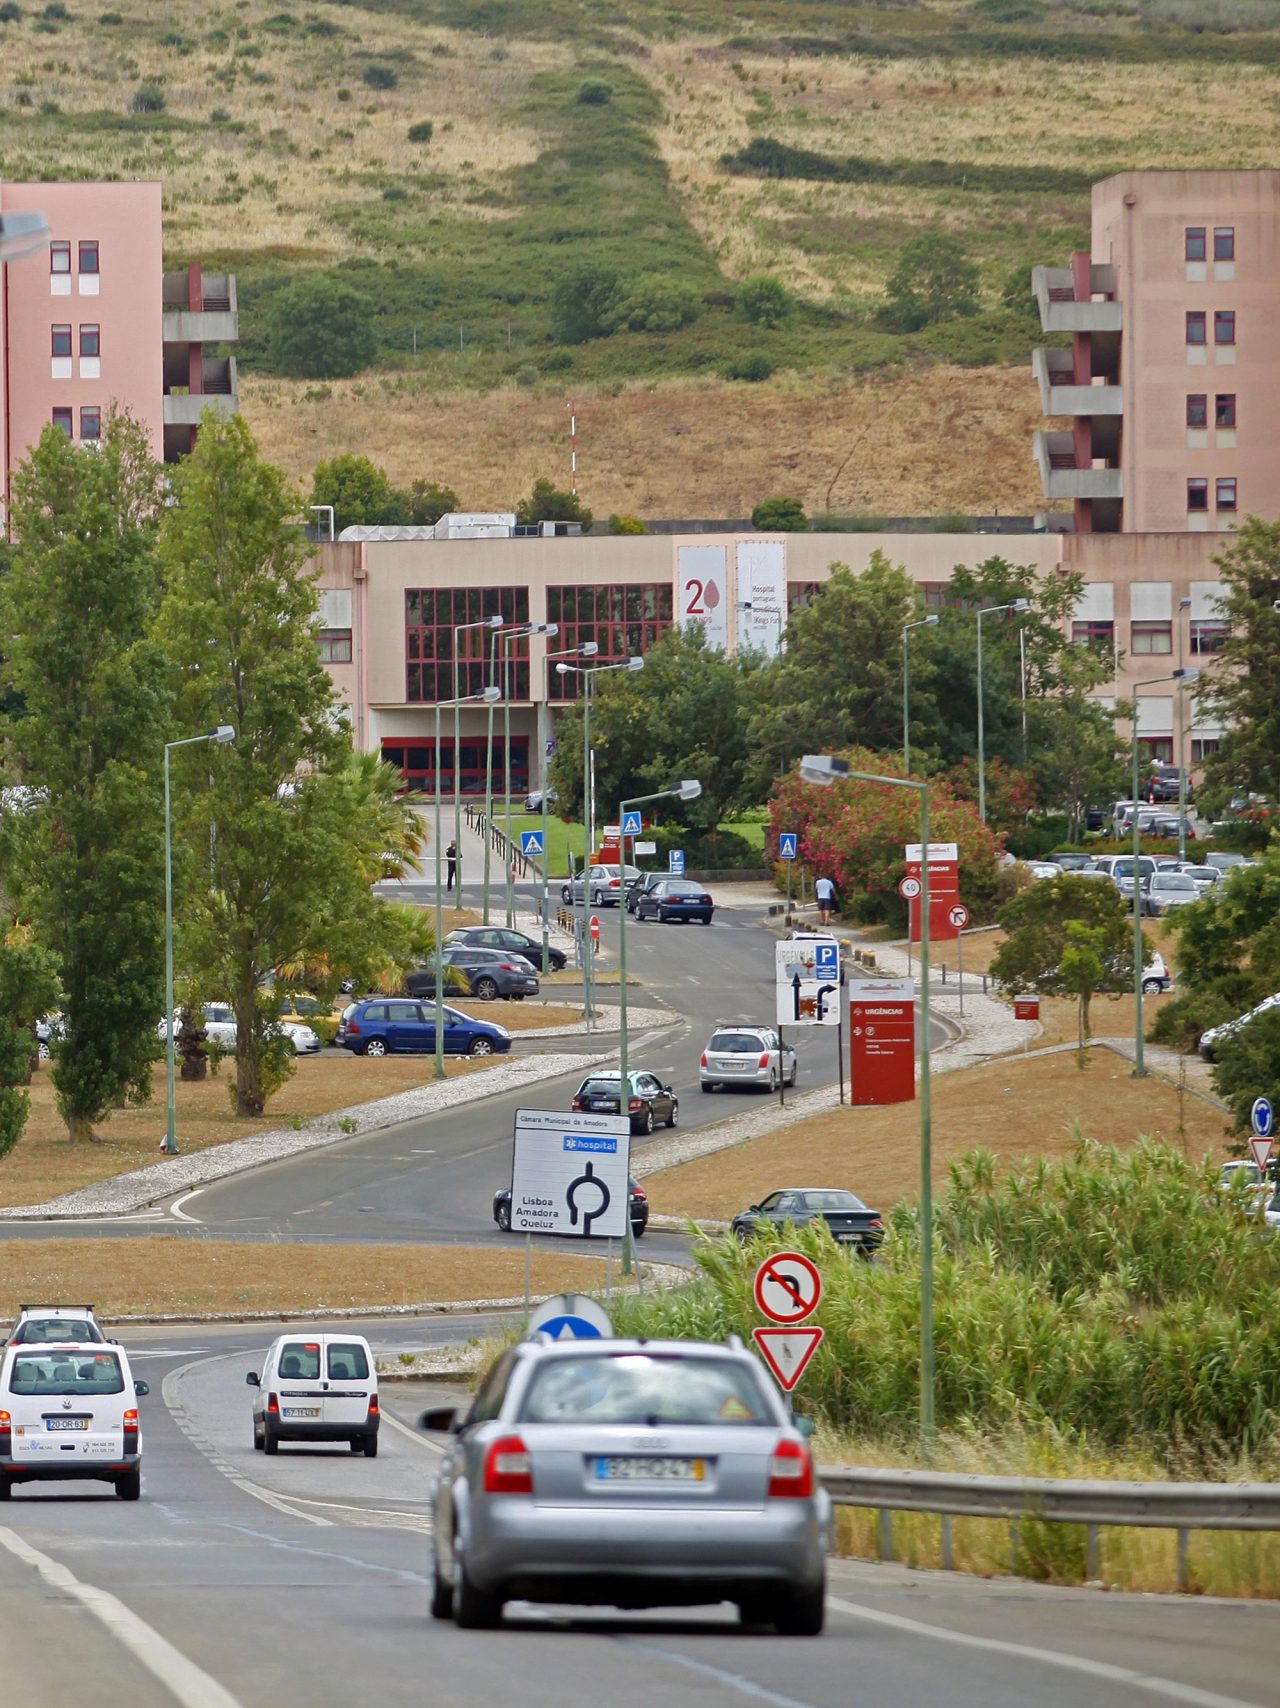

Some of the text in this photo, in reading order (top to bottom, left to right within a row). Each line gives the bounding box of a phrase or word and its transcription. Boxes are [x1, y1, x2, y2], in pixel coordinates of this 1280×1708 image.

[821, 948, 833, 963] P
[583, 1119, 608, 1127] Amadora
[577, 1139, 617, 1151] hospital
[522, 1196, 553, 1206] Lisboa
[516, 1207, 559, 1217] Amadora
[520, 1218, 554, 1228] Queluz
